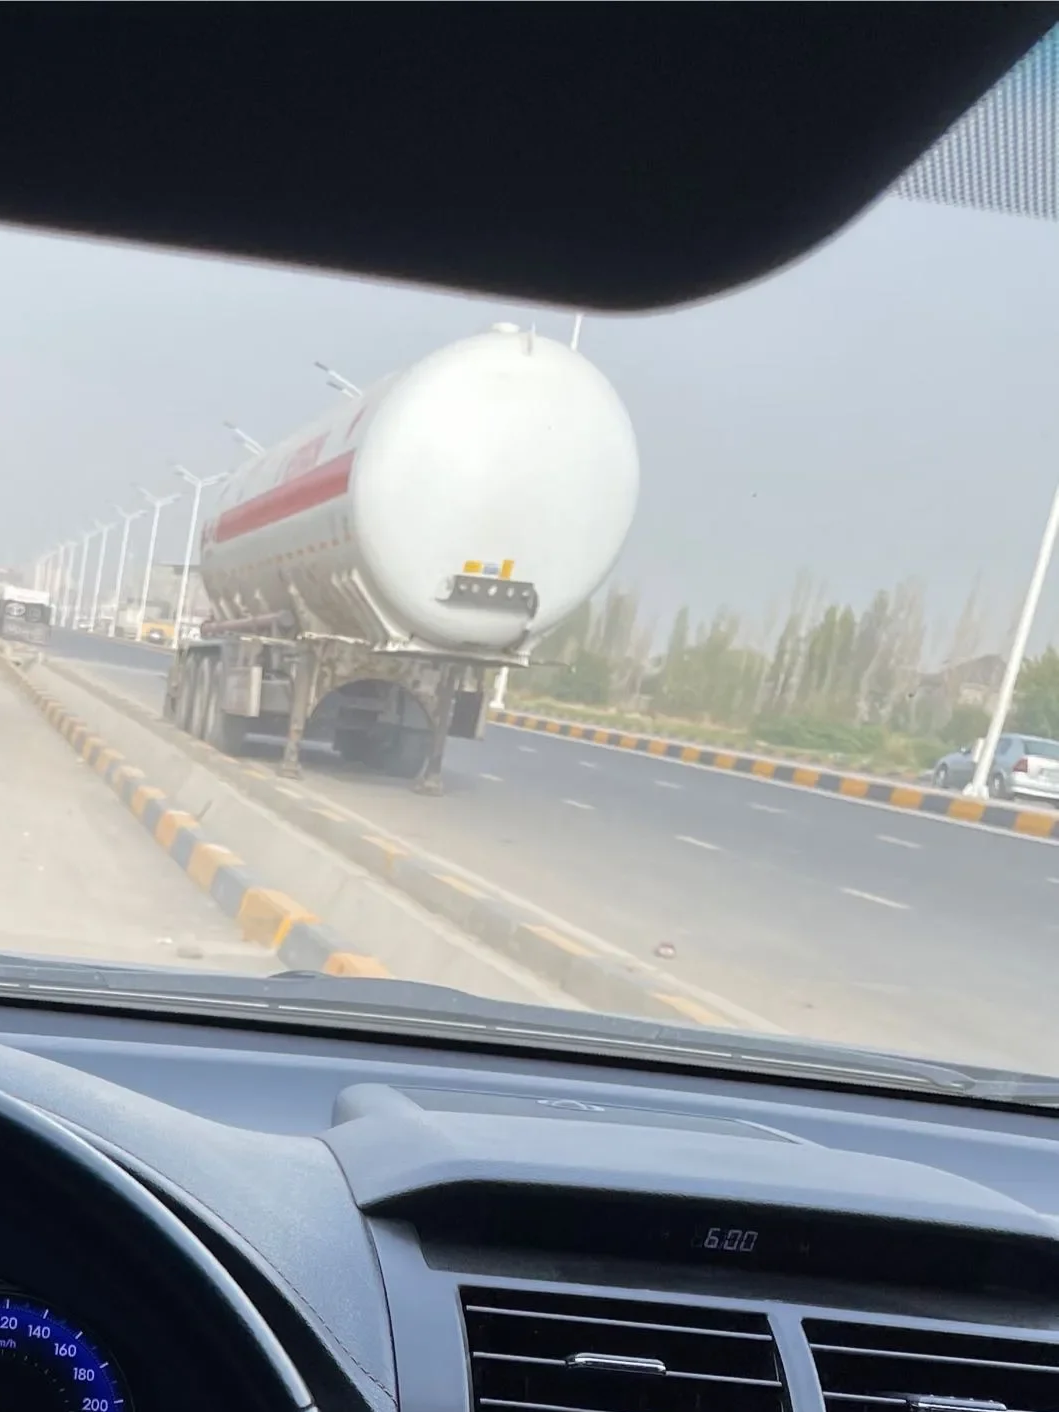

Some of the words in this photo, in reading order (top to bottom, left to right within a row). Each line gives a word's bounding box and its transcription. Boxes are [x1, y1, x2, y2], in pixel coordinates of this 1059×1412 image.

[27, 1324, 51, 1340] 140
[53, 1343, 78, 1358] 160
[72, 1366, 95, 1382] 180
[81, 1397, 109, 1412] 200
